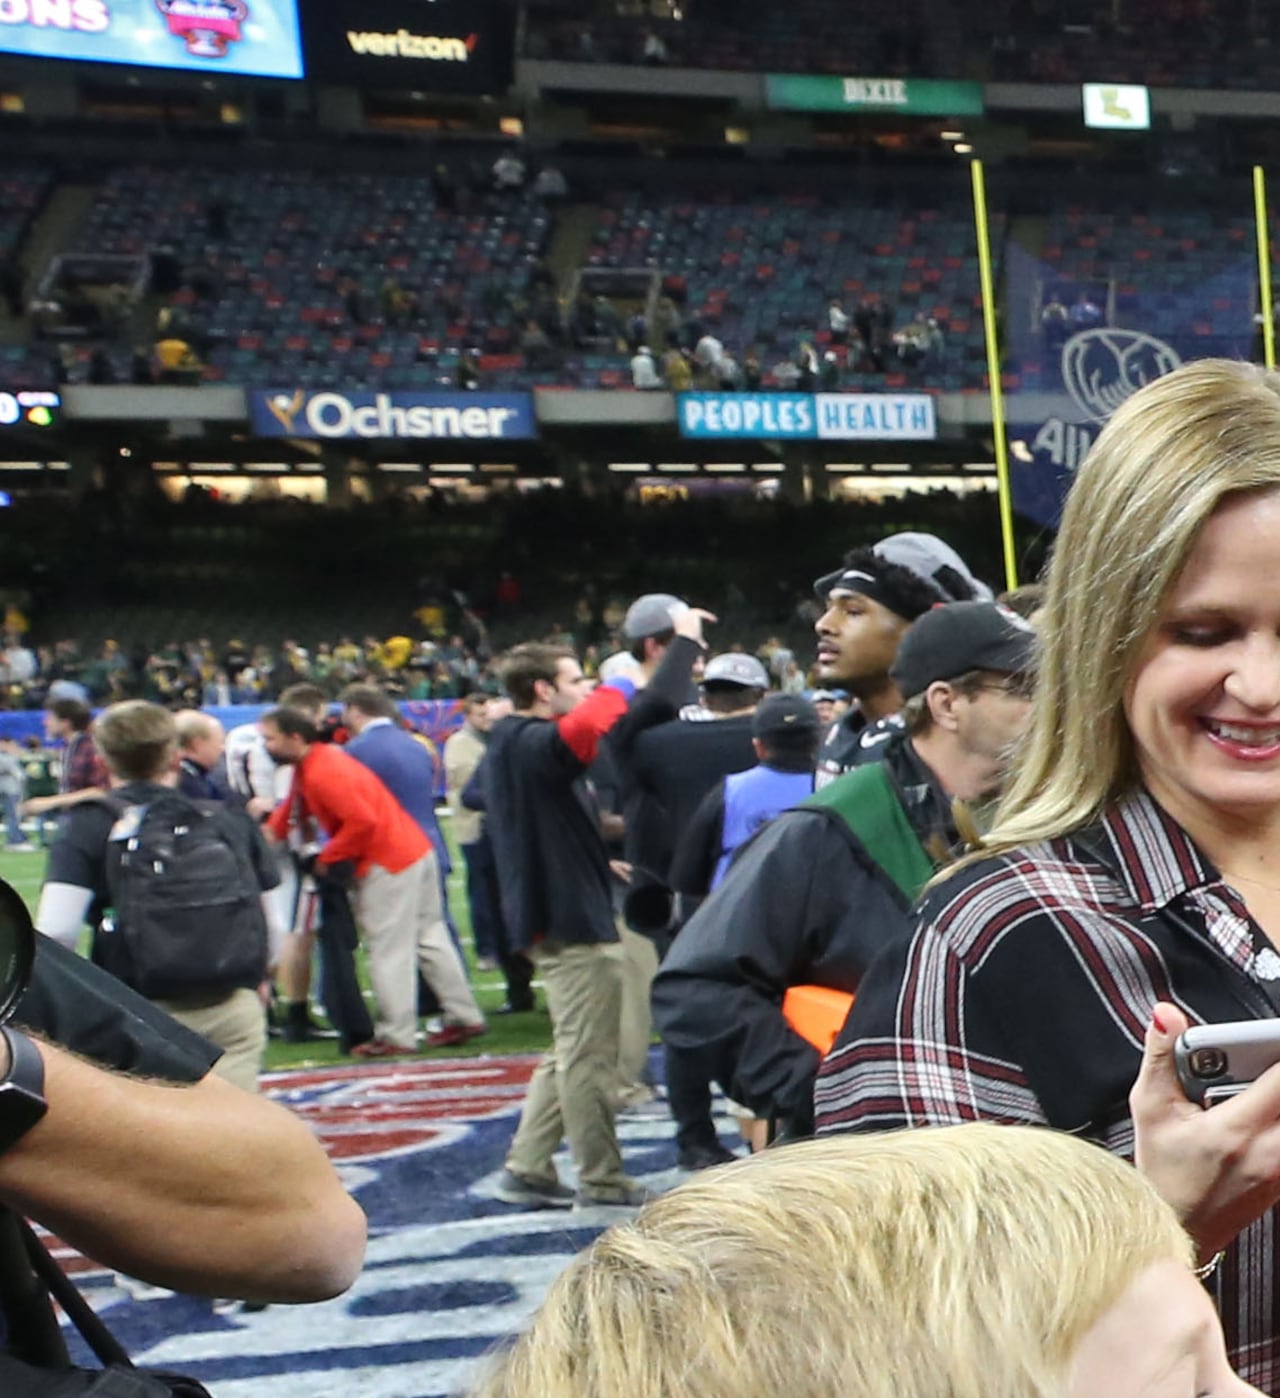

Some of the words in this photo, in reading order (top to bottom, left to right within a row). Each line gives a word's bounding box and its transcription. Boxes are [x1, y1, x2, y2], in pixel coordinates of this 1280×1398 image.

[346, 28, 468, 62] verizon
[306, 392, 510, 437] Ochsner
[684, 399, 812, 432] PEOPLES
[824, 402, 928, 431] HEALTH
